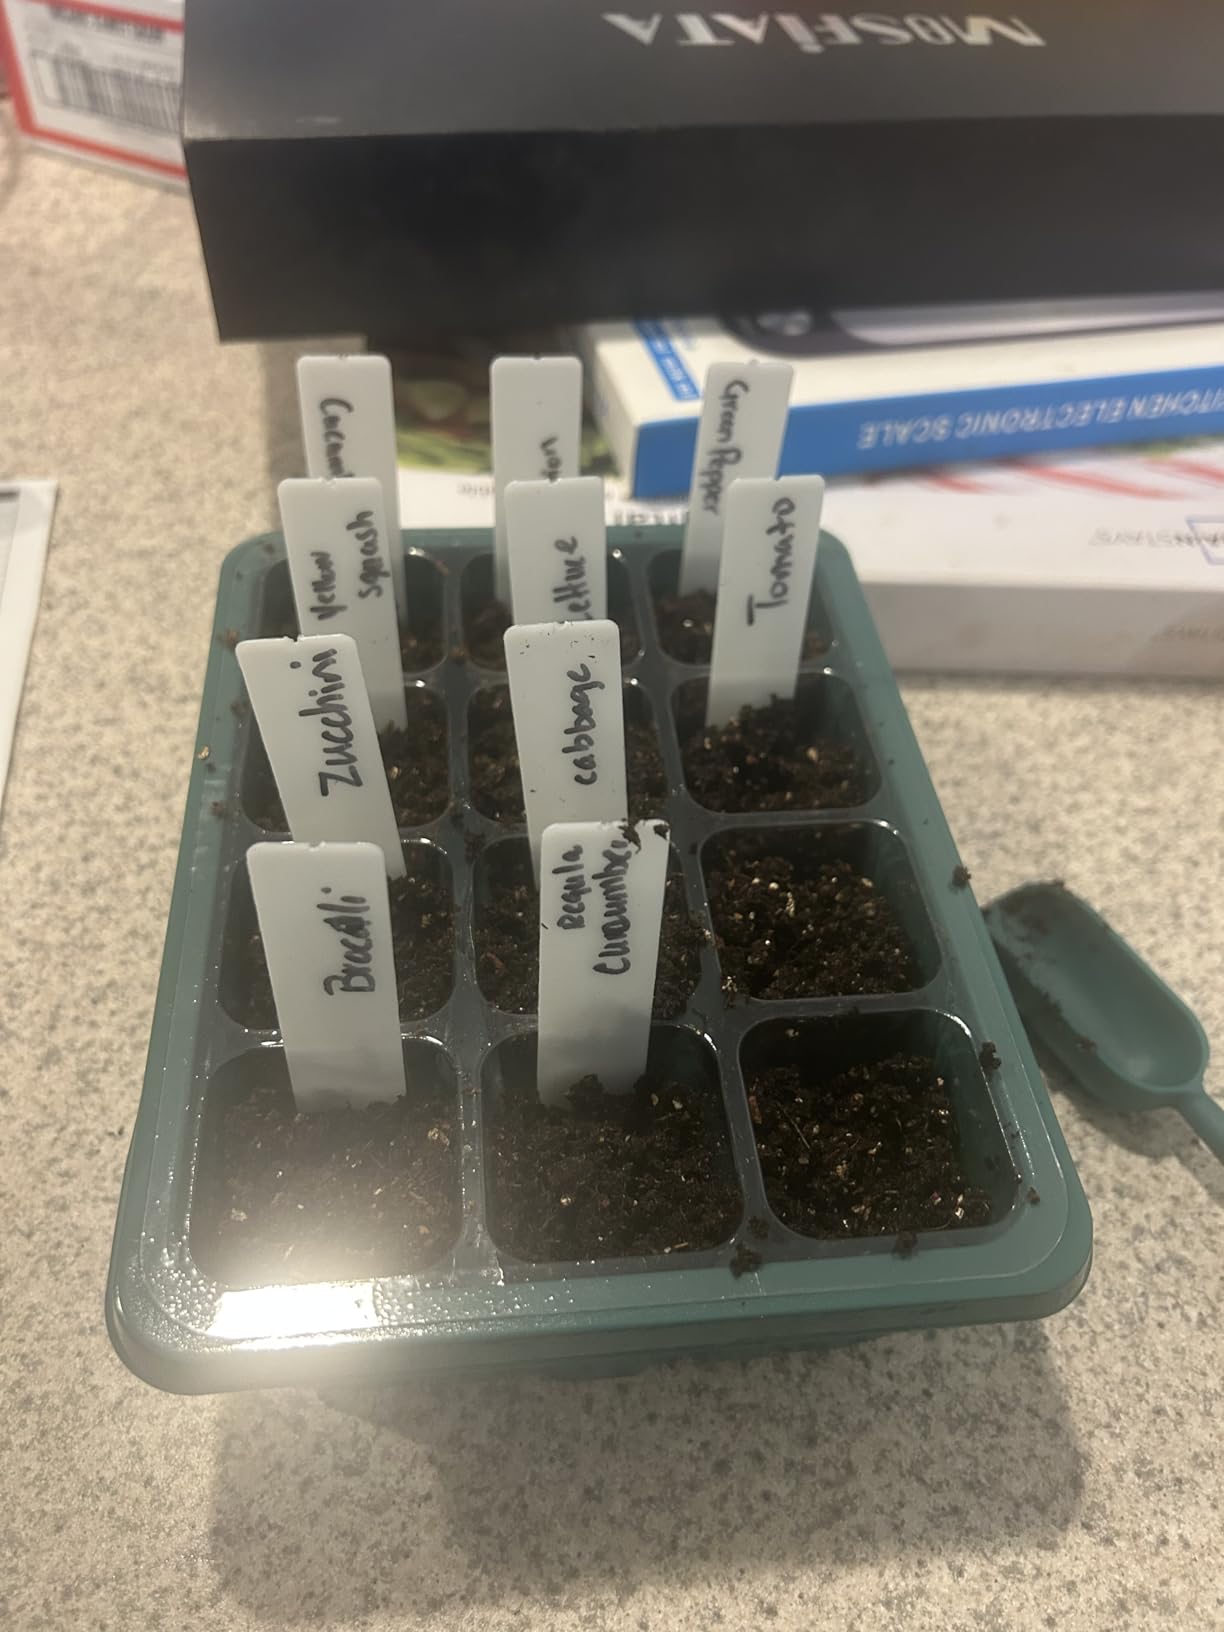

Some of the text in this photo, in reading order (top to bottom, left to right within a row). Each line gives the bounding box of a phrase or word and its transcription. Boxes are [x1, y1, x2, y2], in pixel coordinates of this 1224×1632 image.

[699, 379, 750, 516] Green Pepper
[856, 418, 949, 450] SCALE
[954, 397, 1125, 438] ELECTRONIC
[747, 497, 796, 627] Tomato
[290, 648, 363, 798] Zucchini
[561, 662, 606, 786] cabbage
